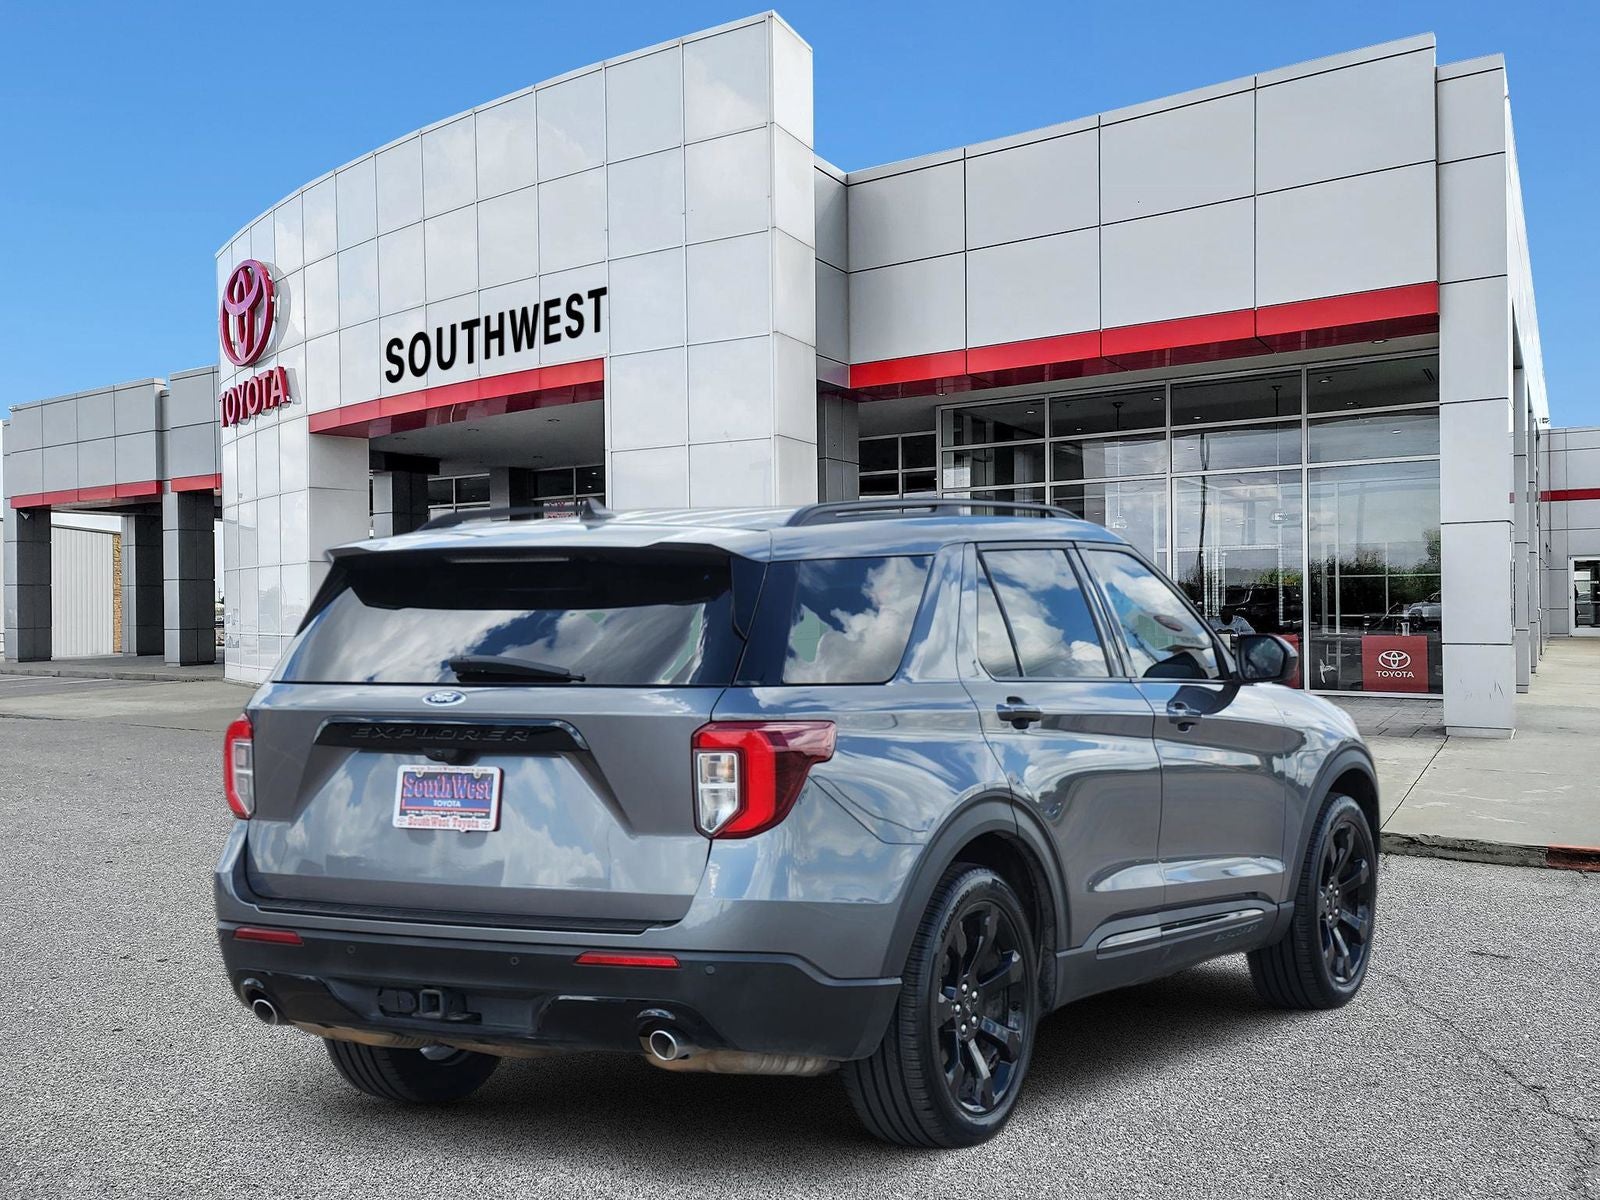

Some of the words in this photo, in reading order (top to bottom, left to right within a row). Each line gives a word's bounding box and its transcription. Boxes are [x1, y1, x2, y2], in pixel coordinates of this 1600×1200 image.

[385, 286, 608, 384] SOUTHWEST
[219, 366, 291, 427] TOYOTA
[1376, 670, 1414, 678] TOYOTA
[352, 727, 530, 741] EXPLORER
[433, 800, 461, 808] TOYOTA
